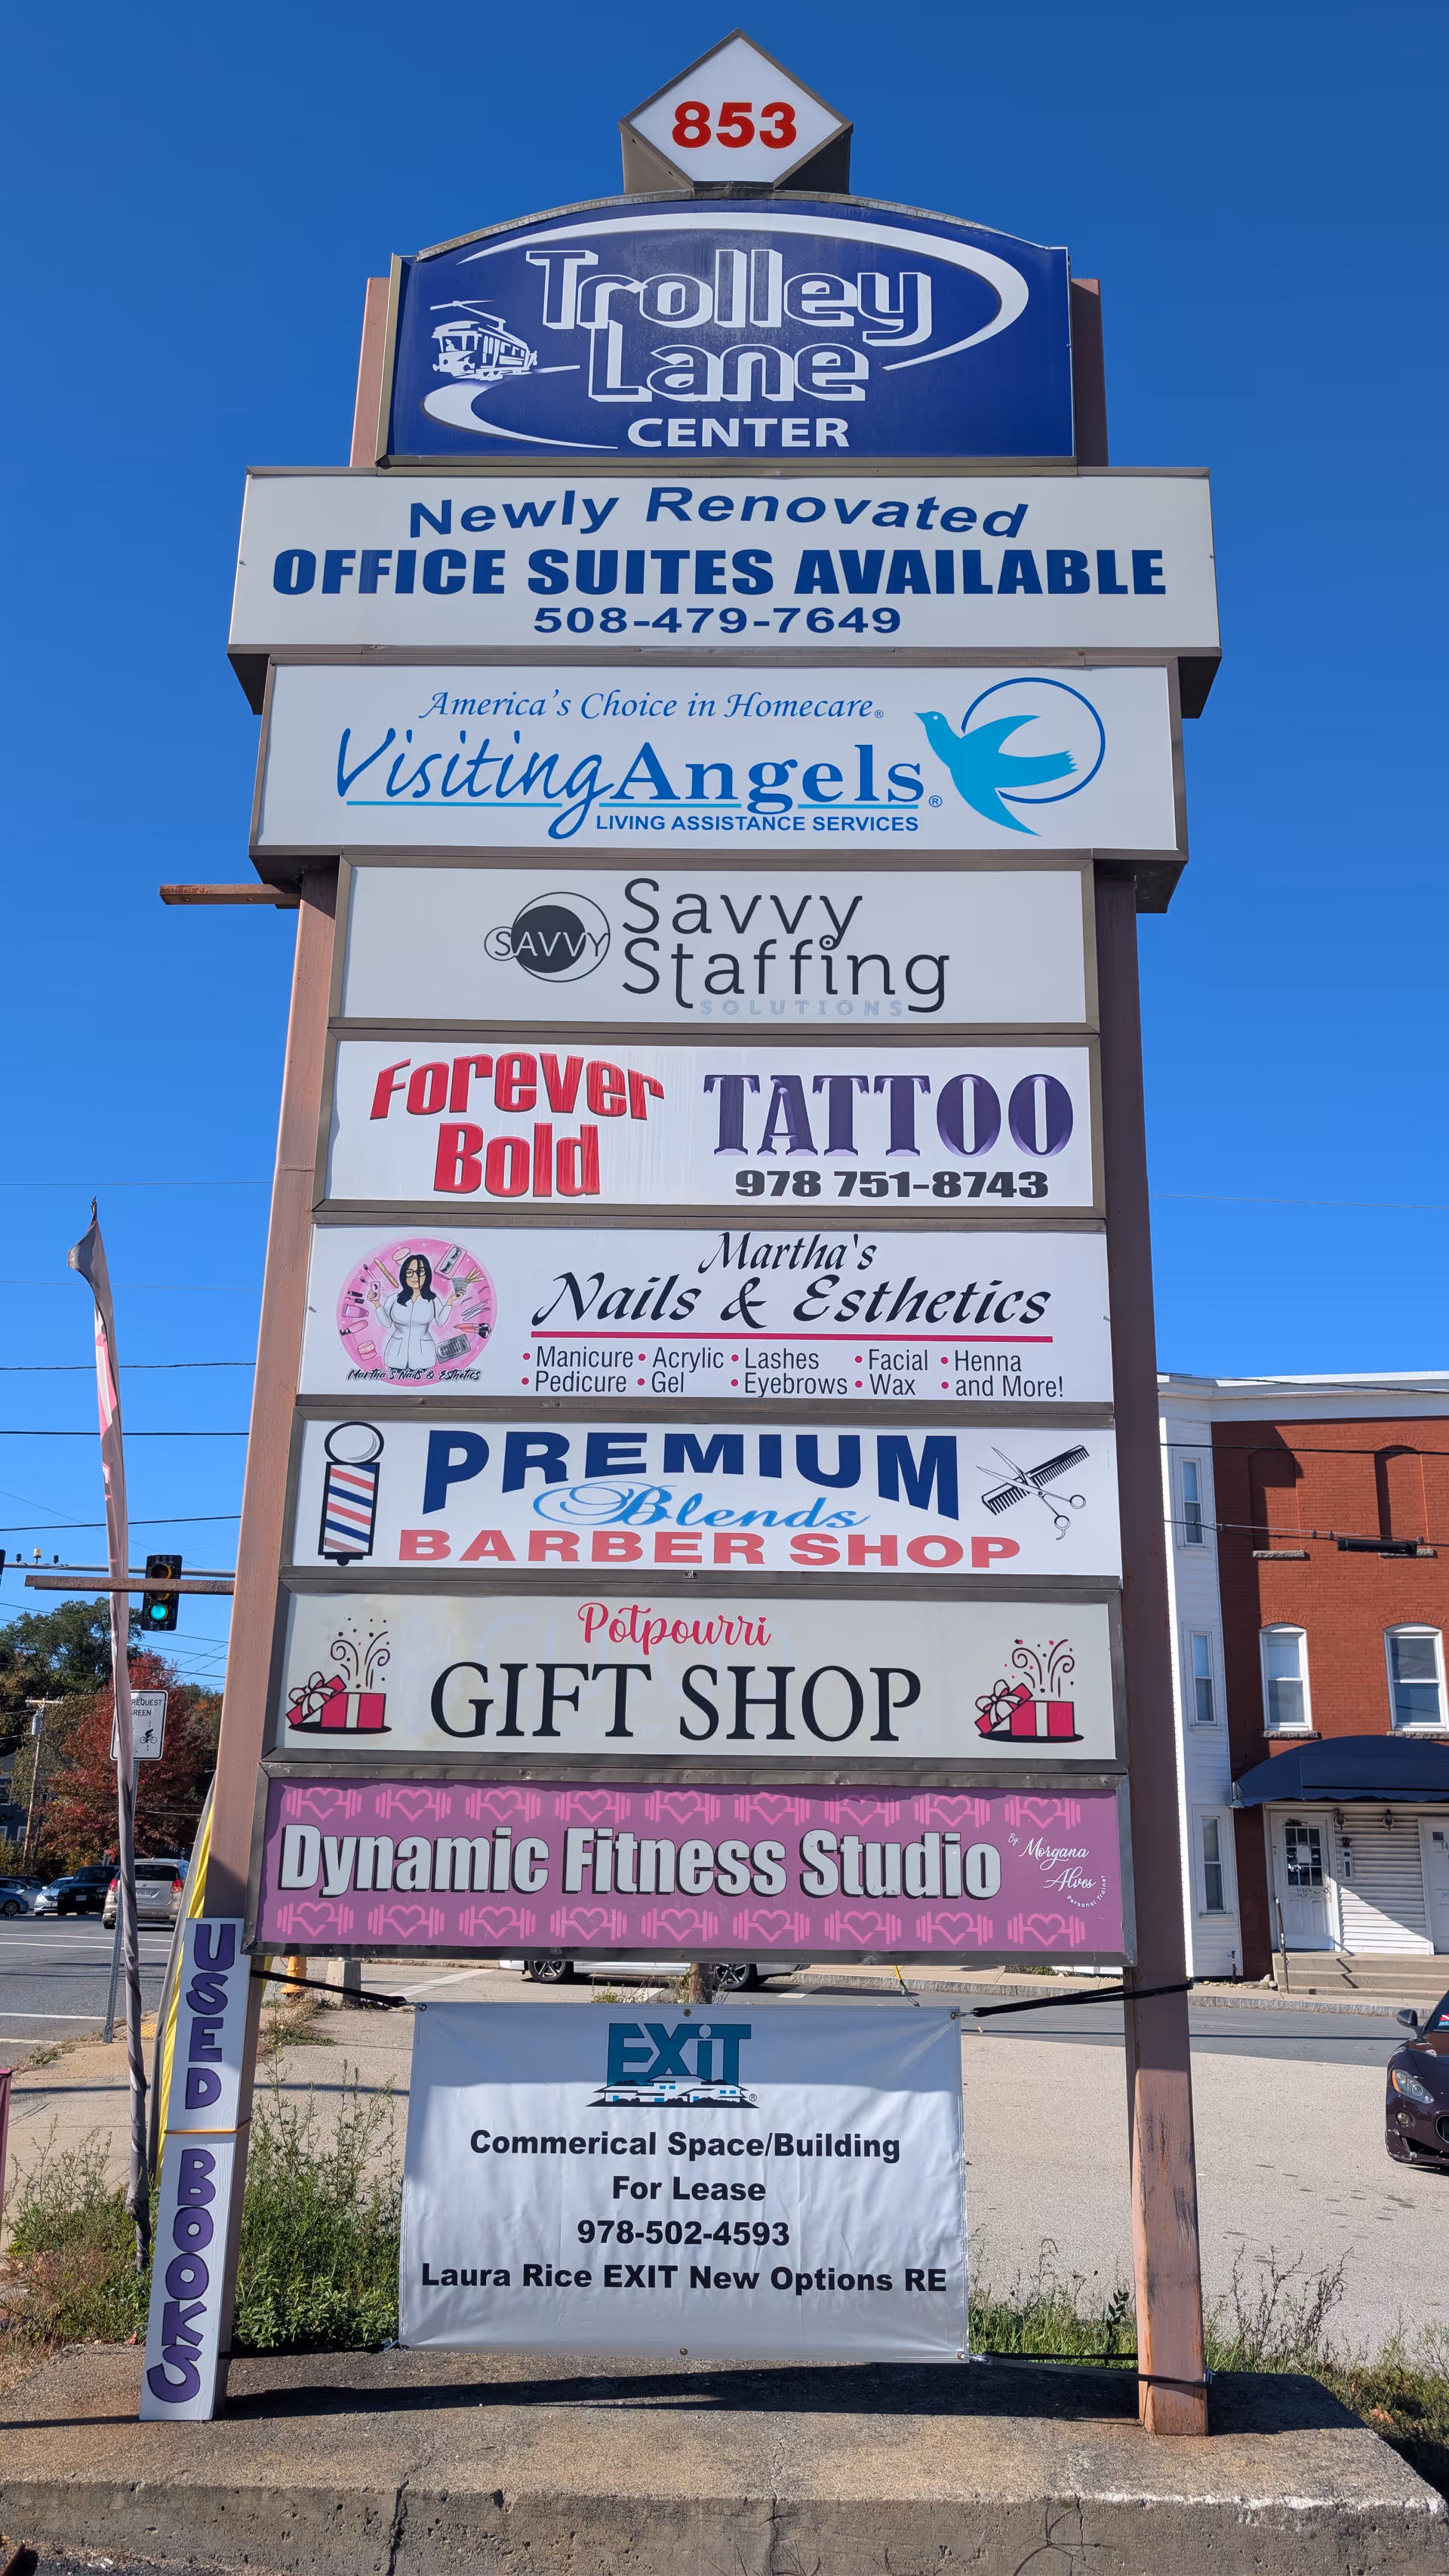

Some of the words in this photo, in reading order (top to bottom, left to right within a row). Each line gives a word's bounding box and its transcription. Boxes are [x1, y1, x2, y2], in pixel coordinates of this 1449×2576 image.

[672, 101, 797, 148] 853
[525, 248, 932, 347] Trolley
[588, 320, 870, 402] Lane
[628, 417, 848, 448] CENTER
[409, 490, 620, 539] Newly
[646, 487, 1029, 539] Renovated
[273, 549, 506, 595] OFFICE
[528, 549, 774, 595] SUITES
[795, 549, 1166, 595] AVAILABLE
[534, 607, 901, 634] 508-479-7649
[418, 689, 572, 719] America's
[580, 689, 678, 719] Choice
[688, 691, 717, 719] in
[337, 728, 614, 839] Visiting
[596, 815, 666, 832] LIVING
[670, 816, 806, 832] ASSISTANCE
[812, 816, 918, 832] SERVICES
[622, 878, 863, 949] Savvy
[494, 931, 609, 957] SAVVY
[622, 936, 949, 1014] Staffing
[700, 999, 902, 1016] SOLUTIONS
[369, 1051, 665, 1121] Forever
[703, 1073, 1074, 1158] TATTOO
[432, 1122, 601, 1199] Bold
[734, 1170, 821, 1199] 978
[834, 1170, 1049, 1199] 751-8743
[697, 1232, 876, 1275] Martha's
[531, 1270, 700, 1325] Nails
[720, 1276, 768, 1328] &
[792, 1274, 1052, 1324] Esthetics
[536, 1346, 633, 1368] Manicure
[652, 1347, 724, 1372] Acrylic
[744, 1347, 820, 1371] Lashes
[868, 1348, 929, 1371] Facial
[953, 1350, 1022, 1372] Henna
[398, 1369, 423, 1380] Nails
[426, 1369, 435, 1380] &
[534, 1371, 627, 1393] Pedicure
[651, 1371, 686, 1394] Gel
[744, 1372, 848, 1398] Eyebrows
[869, 1374, 916, 1396] Wax
[955, 1374, 995, 1397] and
[1001, 1374, 1063, 1397] More!
[423, 1430, 959, 1520] PREMIUM
[533, 1480, 872, 1530] Blends
[398, 1528, 764, 1565] BARBER
[788, 1532, 1020, 1568] SHOP
[577, 1602, 771, 1656] Potpourri
[429, 1661, 652, 1738] GIFT
[679, 1664, 921, 1741] SHOP
[278, 1824, 549, 1897] Dynamic
[564, 1826, 786, 1897] Fitness
[798, 1828, 1002, 1899] Studio
[1008, 1833, 1021, 1846] By:
[1019, 1837, 1090, 1870] Morgana
[1043, 1867, 1097, 1891] Alves
[1066, 1894, 1097, 1907] Personal
[1096, 1875, 1106, 1900] Trainer
[186, 1924, 235, 2110] USED
[469, 2130, 657, 2156] Commerical
[667, 2131, 901, 2164] Space/Building
[612, 2176, 663, 2200] For
[672, 2176, 766, 2202] Lease
[577, 2219, 789, 2246] 978-502-4593
[147, 2149, 216, 2403] BOOKS
[421, 2262, 510, 2287] Laura
[523, 2263, 592, 2288] Rice
[604, 2264, 678, 2288] EXIT
[690, 2265, 759, 2290] New
[771, 2265, 894, 2295] Options
[905, 2267, 947, 2291] RE
